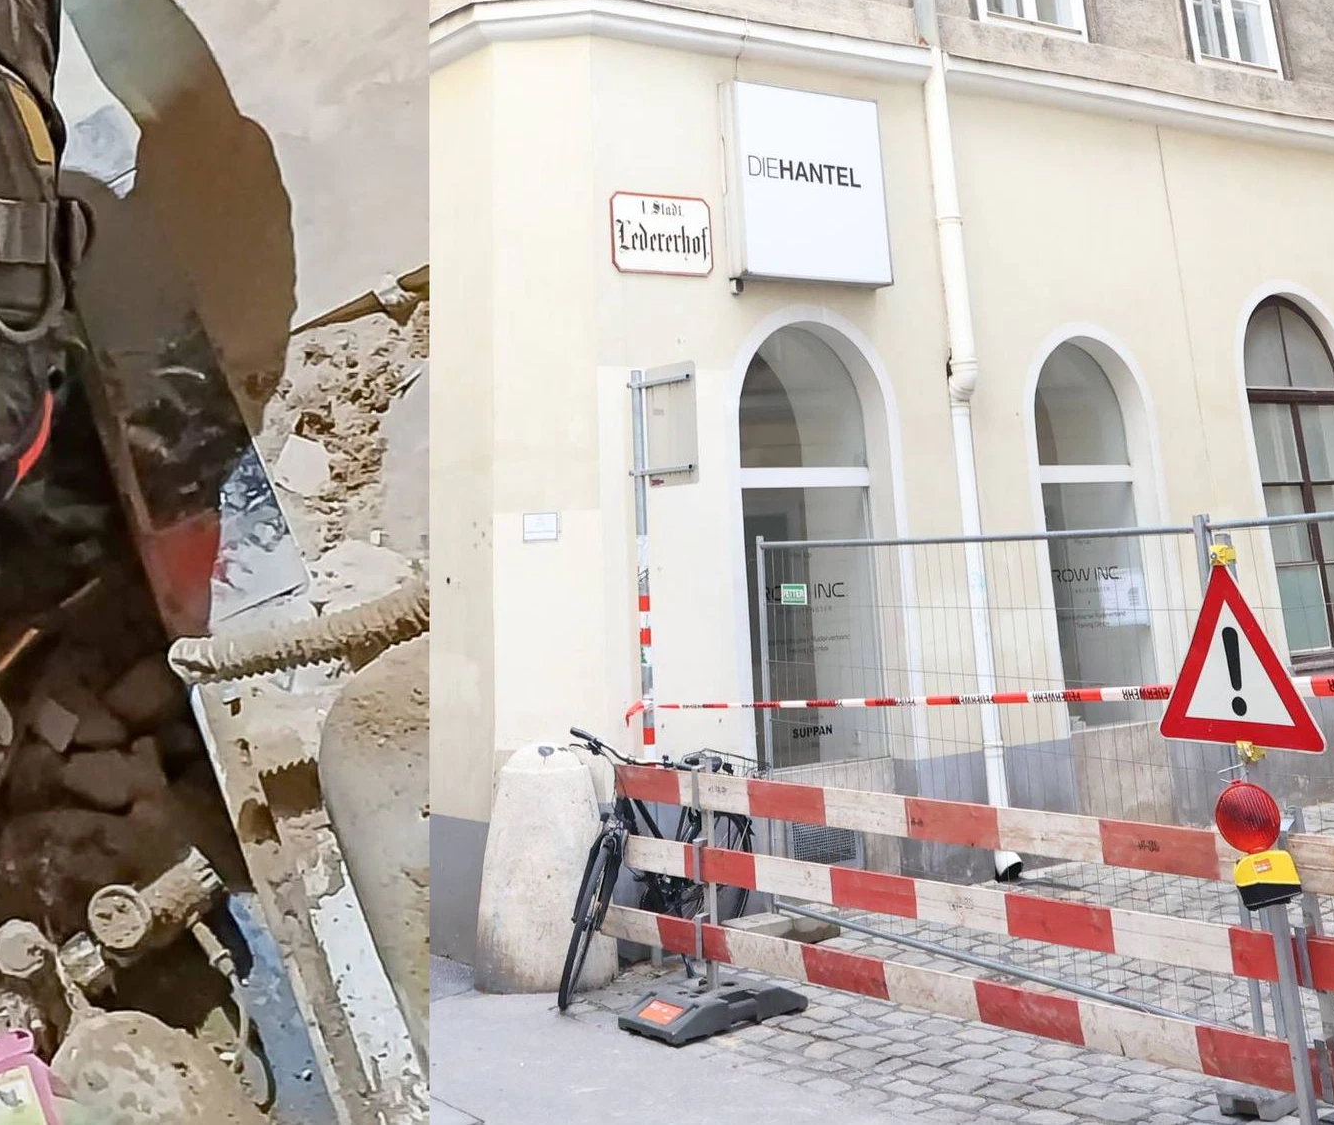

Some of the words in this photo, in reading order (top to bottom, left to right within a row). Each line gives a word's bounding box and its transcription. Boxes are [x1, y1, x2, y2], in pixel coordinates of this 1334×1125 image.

[747, 154, 862, 188] DIEHANTEL
[1032, 691, 1082, 703] FEUERWEHR
[1122, 687, 1169, 701] EUERWEHR
[792, 724, 833, 739] SUPPAN
